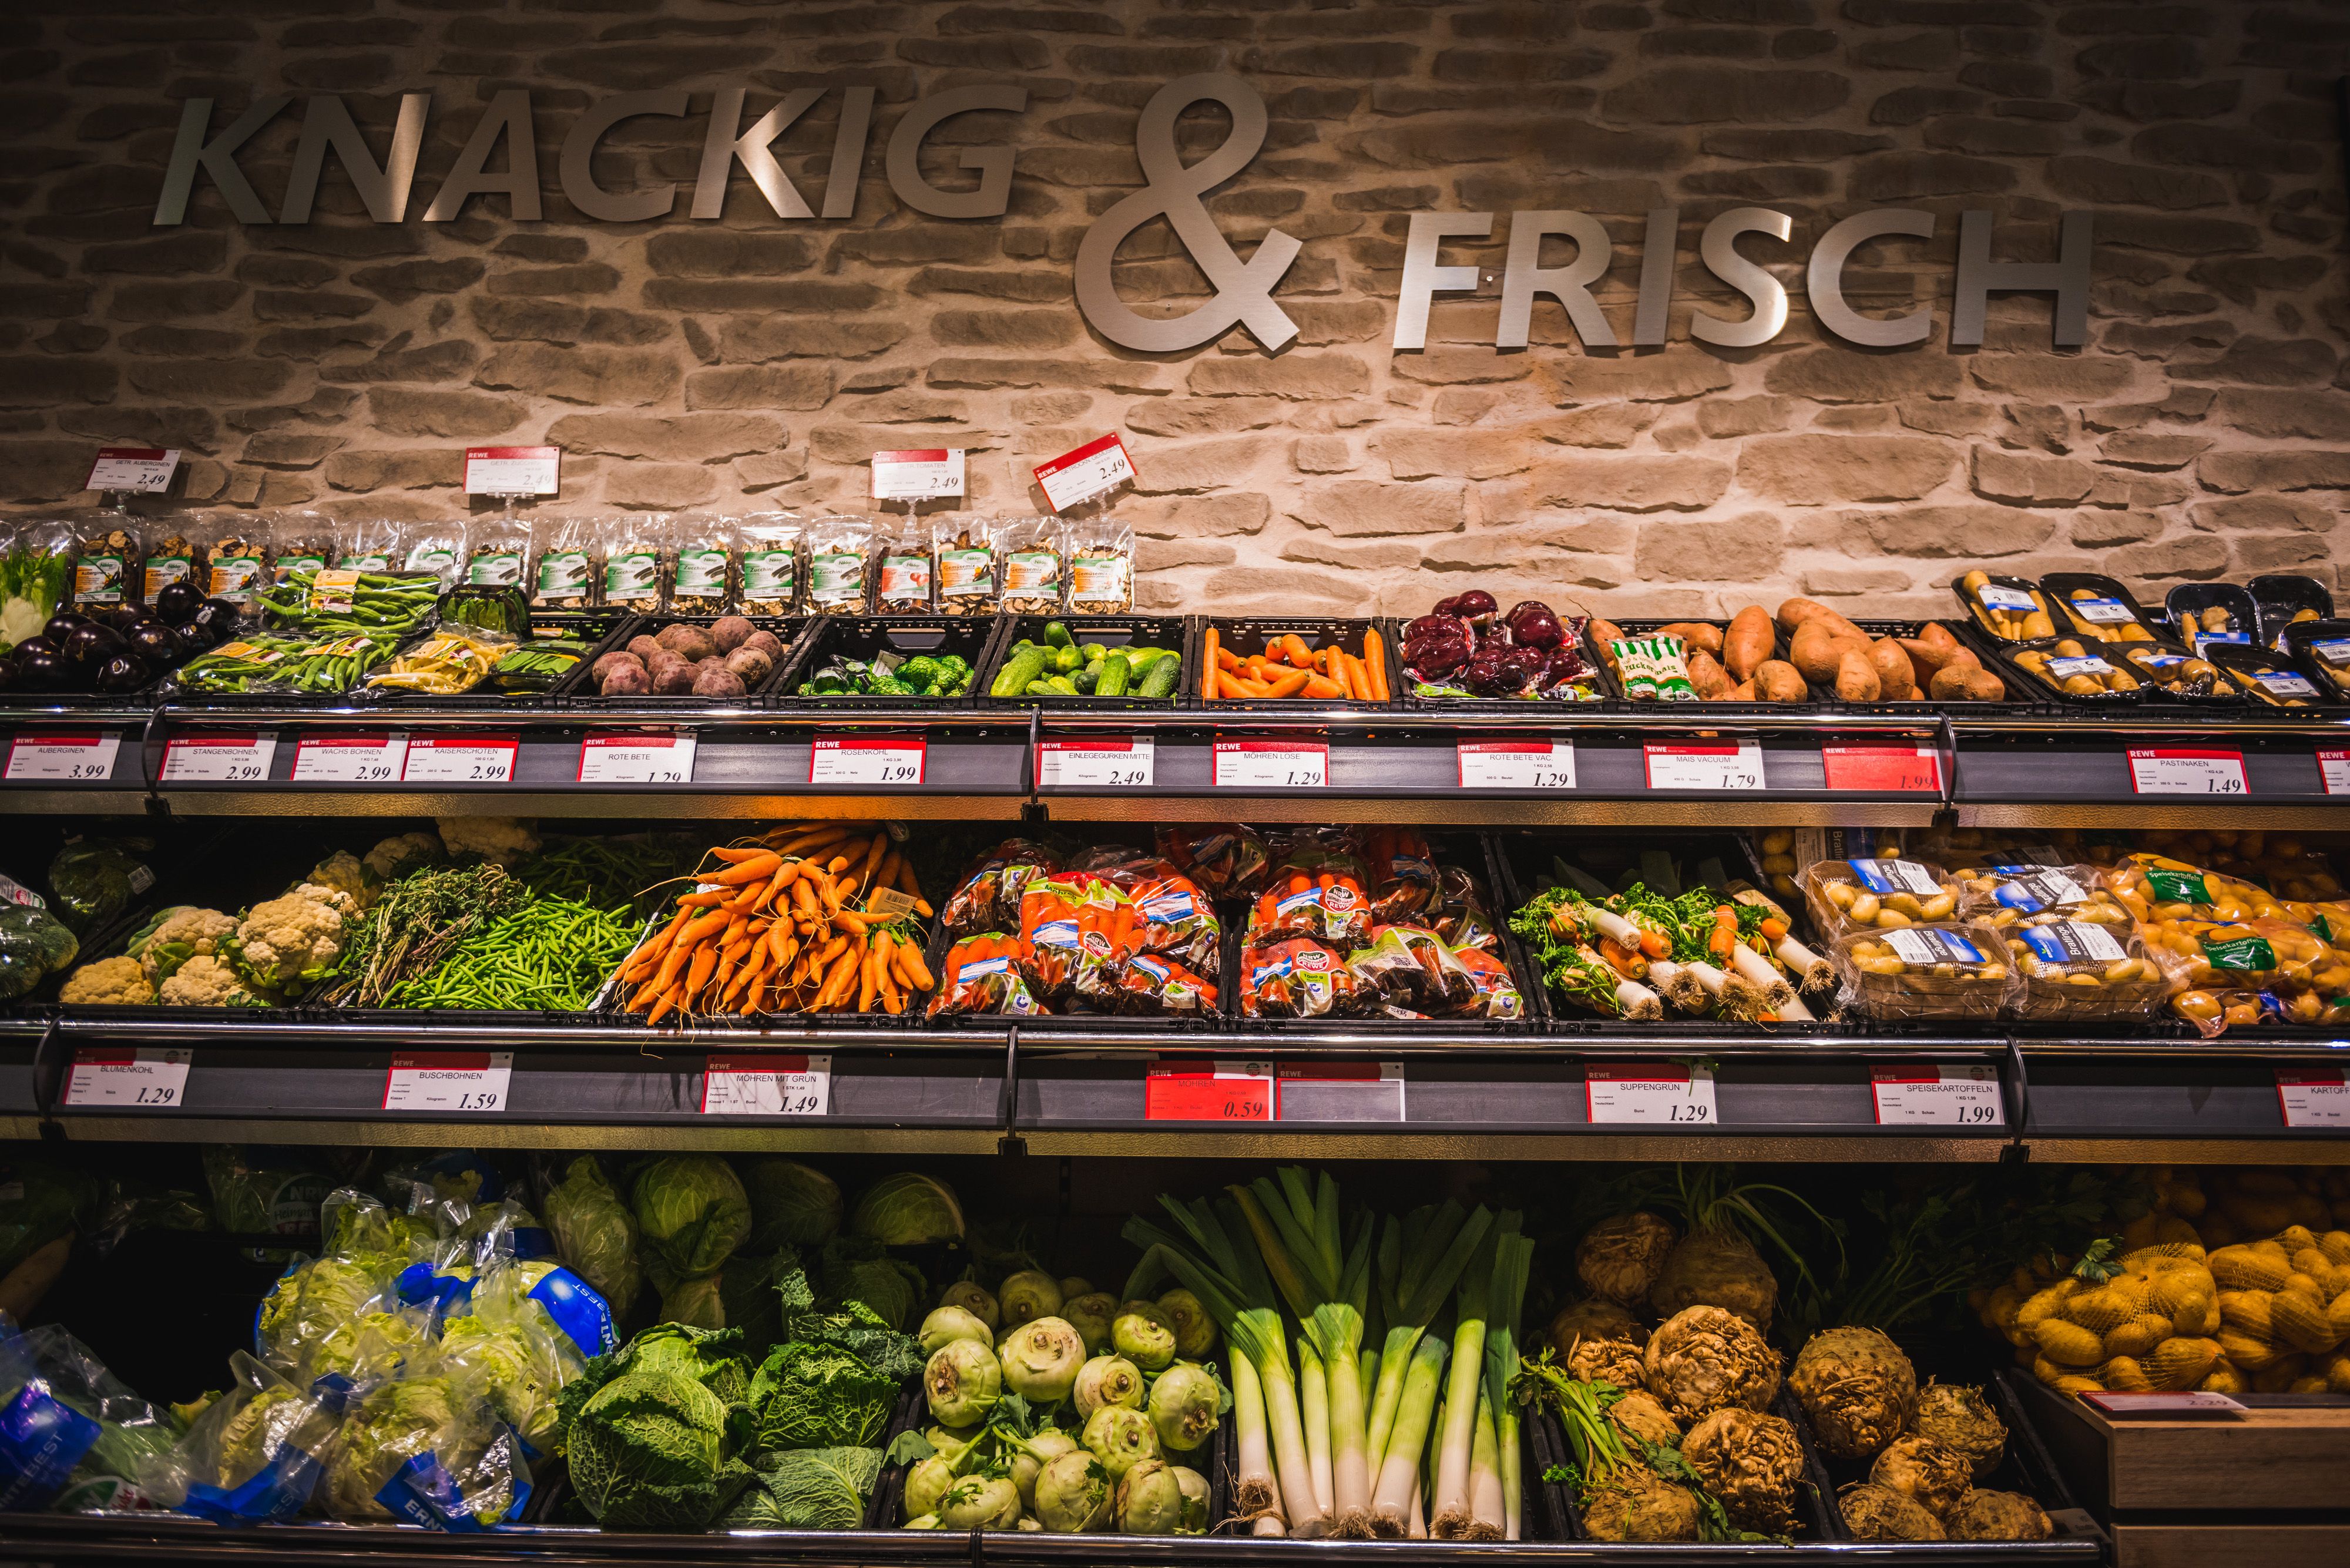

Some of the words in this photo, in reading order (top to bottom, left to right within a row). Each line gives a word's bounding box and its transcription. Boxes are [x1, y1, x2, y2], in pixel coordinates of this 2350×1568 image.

[154, 85, 1028, 225] KNACKIG
[1074, 72, 1304, 354] &
[1392, 208, 2093, 351] FRISCH
[1037, 466, 1058, 479] REWE
[1099, 459, 1125, 480] 2.49
[137, 474, 166, 485] 2.49
[522, 474, 552, 485] 2.49
[930, 477, 958, 488] 2.49
[69, 764, 105, 778] 3.99
[225, 766, 261, 780] 2.99
[354, 766, 391, 780] 2.99
[469, 765, 506, 780] 2.99
[880, 766, 916, 781] 1.99
[1108, 771, 1144, 785] 2.49
[1285, 771, 1321, 785] 1.29
[1533, 773, 1568, 787] 1.29
[1721, 774, 1755, 788] 1.79
[1900, 775, 1934, 789] 1.99
[2208, 778, 2241, 793] 1.49
[2149, 871, 2200, 882] Speisekartoffeln
[1333, 888, 1349, 899] NRW
[2056, 925, 2082, 956] Bratlinge
[2203, 937, 2265, 952] Speisekartoffeln
[100, 1065, 154, 1074] BLUMENKOHL
[419, 1072, 482, 1080] BUSCHBOHNEN
[737, 1074, 773, 1082] MÖHREN
[792, 1074, 817, 1083] GRÜN
[1620, 1082, 1680, 1091] SUPPENGRÜN
[1906, 1084, 1993, 1093] SPEISEKARTOFFELN
[135, 1087, 174, 1104] 1.29
[457, 1093, 497, 1109] 1.59
[778, 1096, 818, 1113] 1.49
[1224, 1101, 1263, 1117] 0.59
[1668, 1104, 1707, 1122] 1.29
[1956, 1106, 1995, 1123] 1.99
